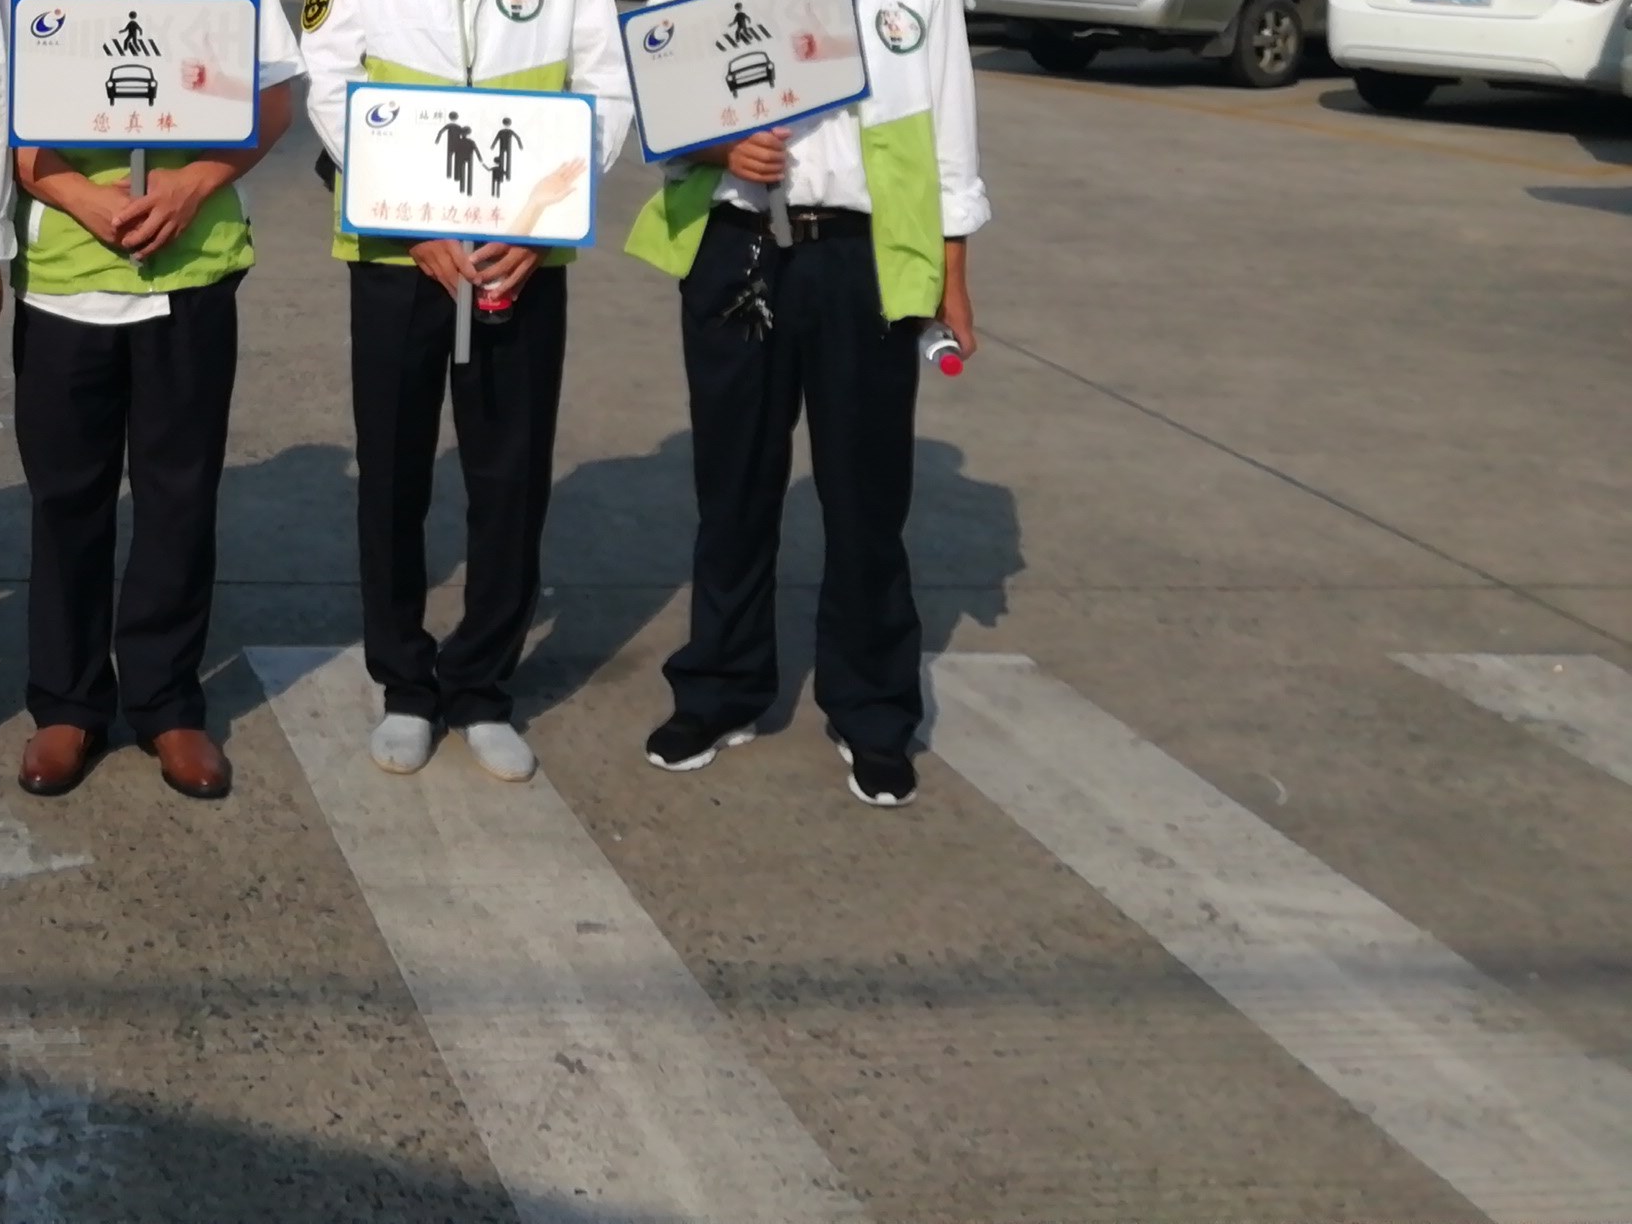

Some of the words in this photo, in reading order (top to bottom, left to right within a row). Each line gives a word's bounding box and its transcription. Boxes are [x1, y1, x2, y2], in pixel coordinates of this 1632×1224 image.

[92, 110, 178, 133] 您真棒
[370, 199, 505, 229] 请您靠边候车
